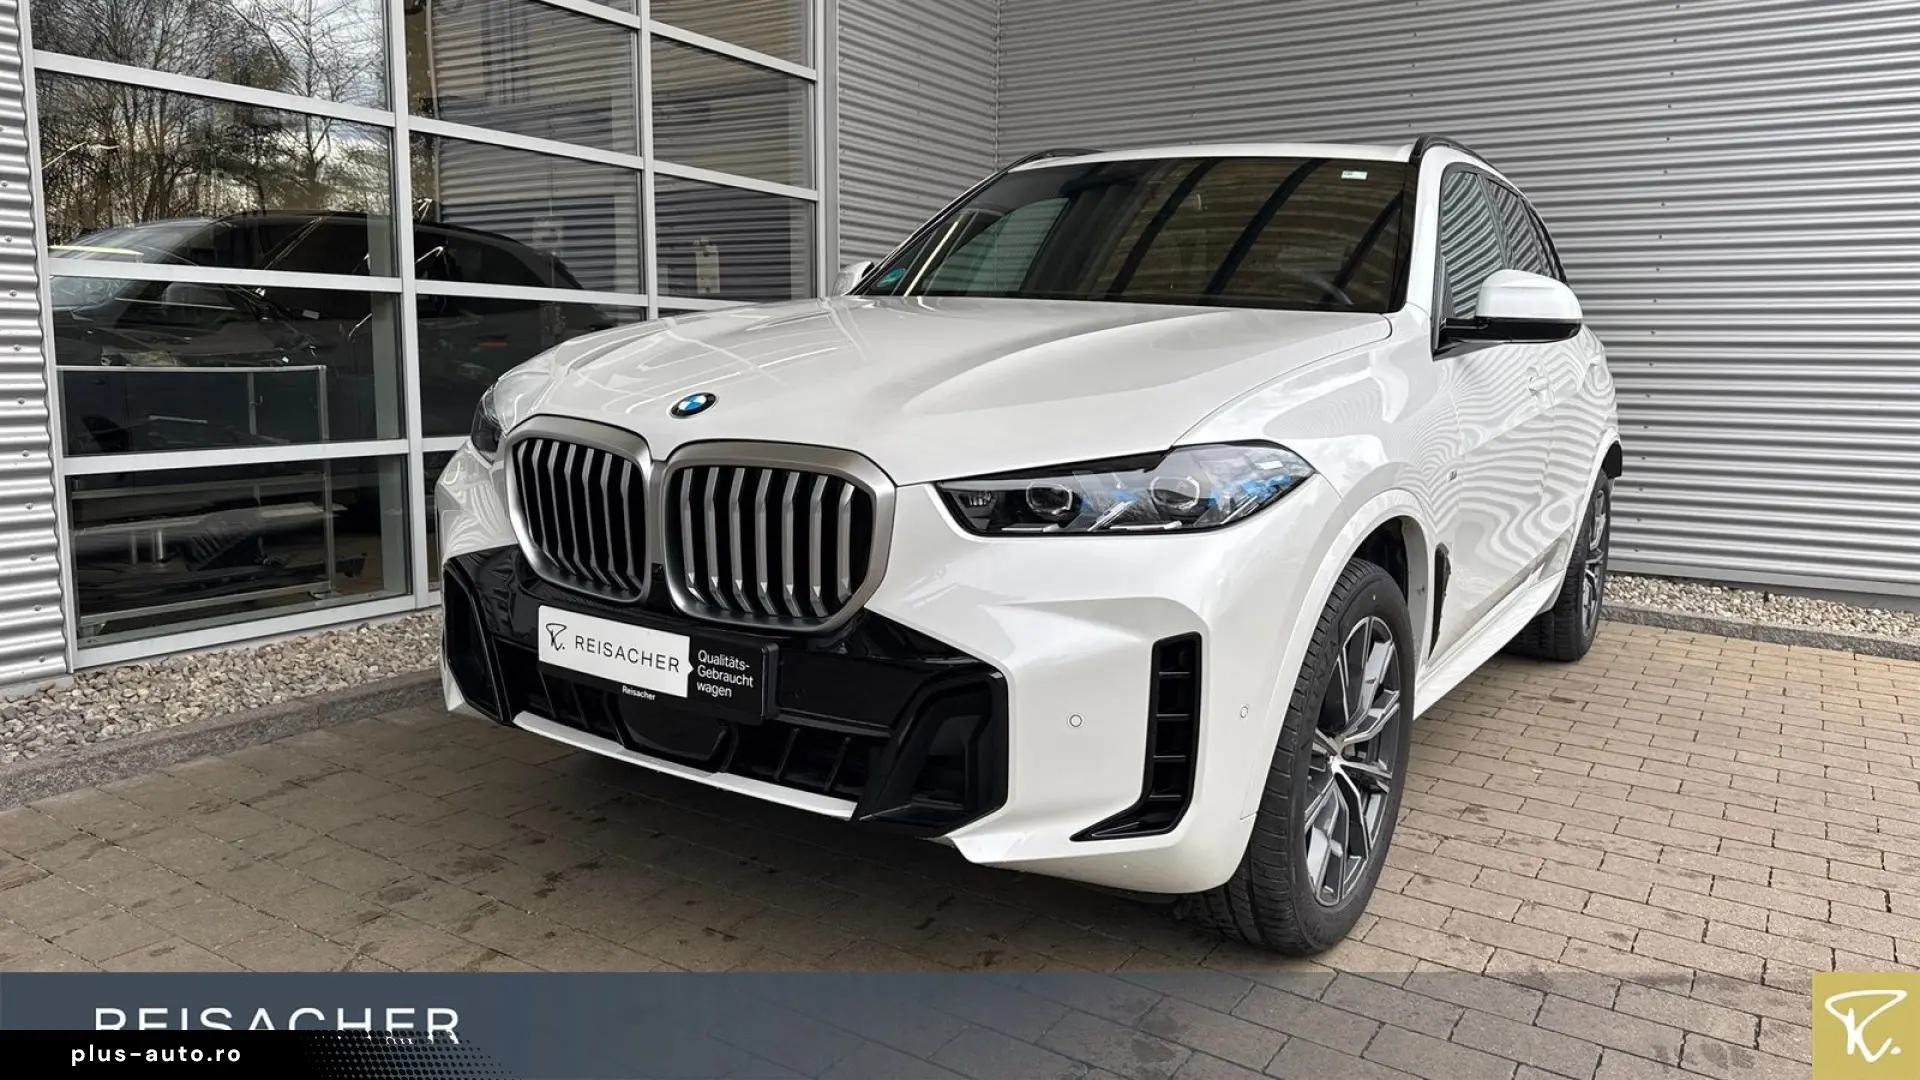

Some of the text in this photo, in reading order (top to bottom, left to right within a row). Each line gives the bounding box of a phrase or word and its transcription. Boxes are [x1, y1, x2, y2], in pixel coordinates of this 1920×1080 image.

[575, 635, 680, 673] REISACHER
[697, 649, 751, 671] Qualitäts-
[697, 664, 754, 688] Gebraucht
[622, 684, 656, 700] Reisacher
[696, 681, 732, 698] wagen
